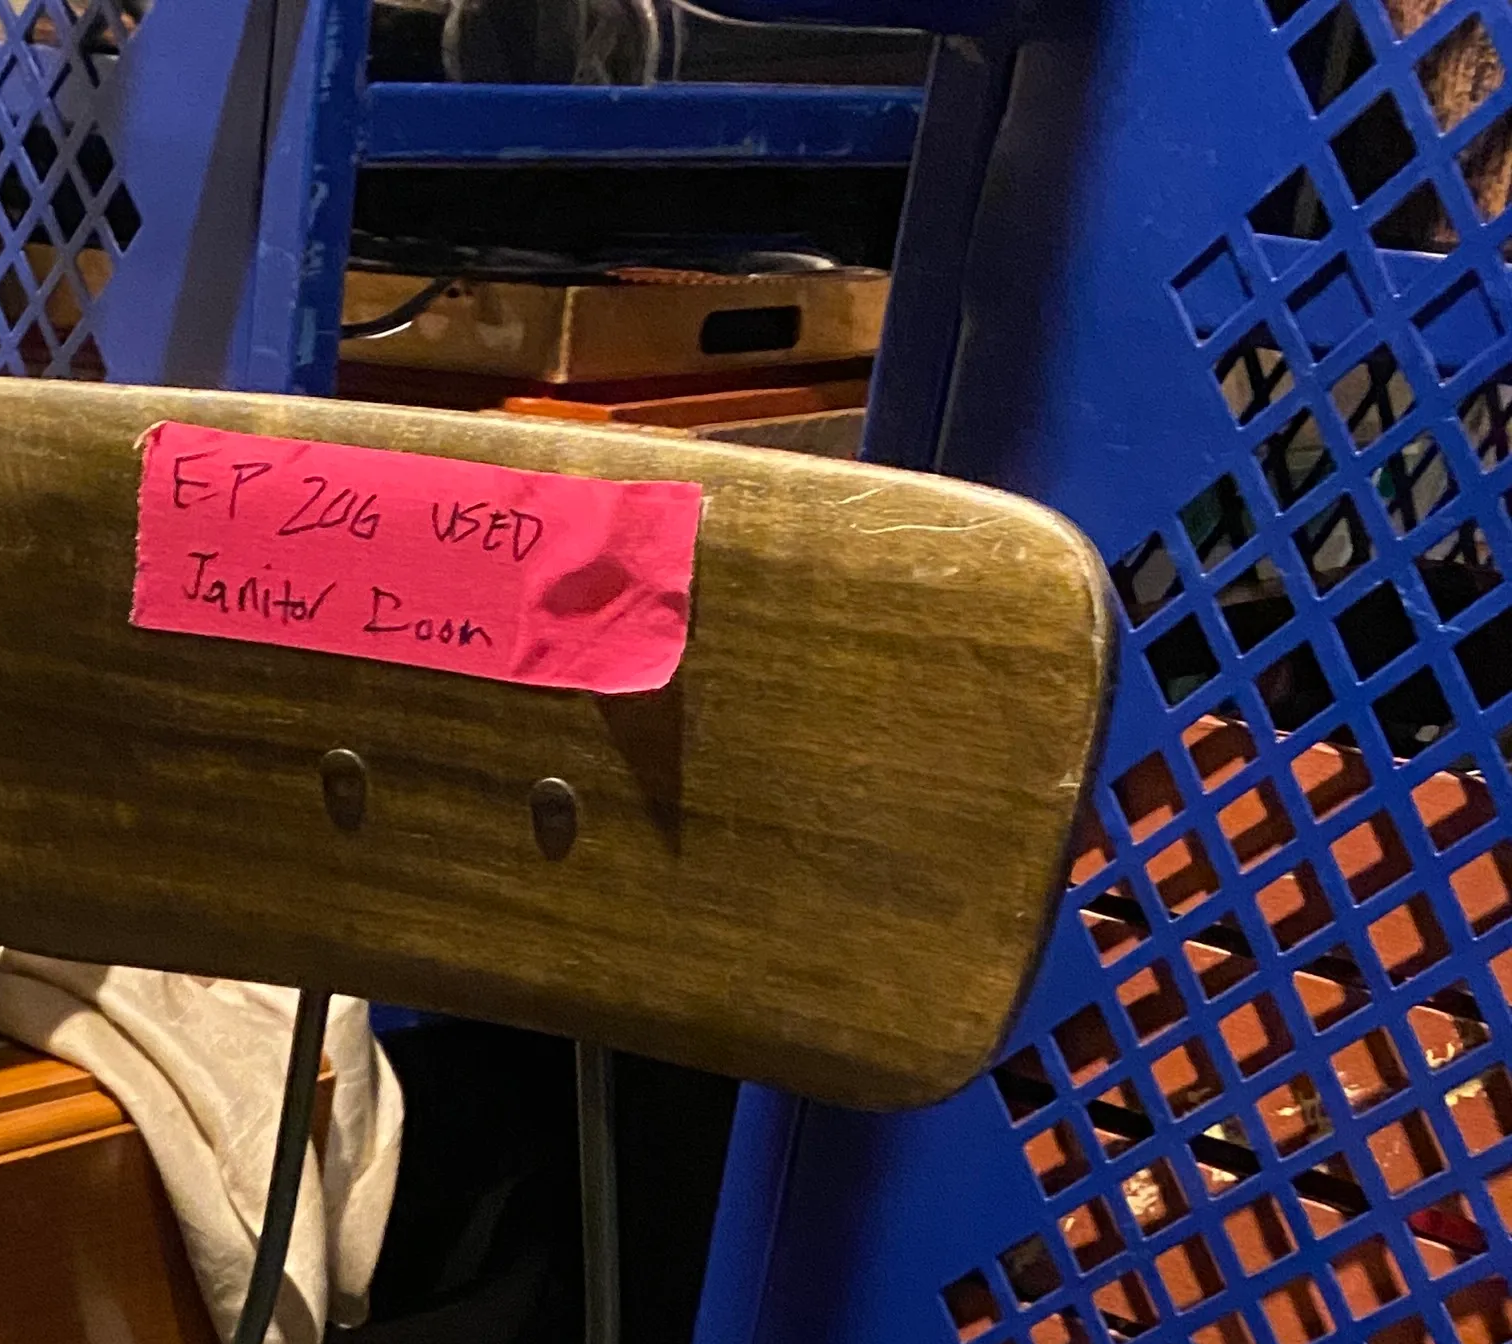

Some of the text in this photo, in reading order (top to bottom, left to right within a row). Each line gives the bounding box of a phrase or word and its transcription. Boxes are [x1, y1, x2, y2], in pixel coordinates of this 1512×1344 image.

[173, 448, 272, 520] EP
[432, 501, 544, 562] USED
[181, 551, 337, 626] Janitor
